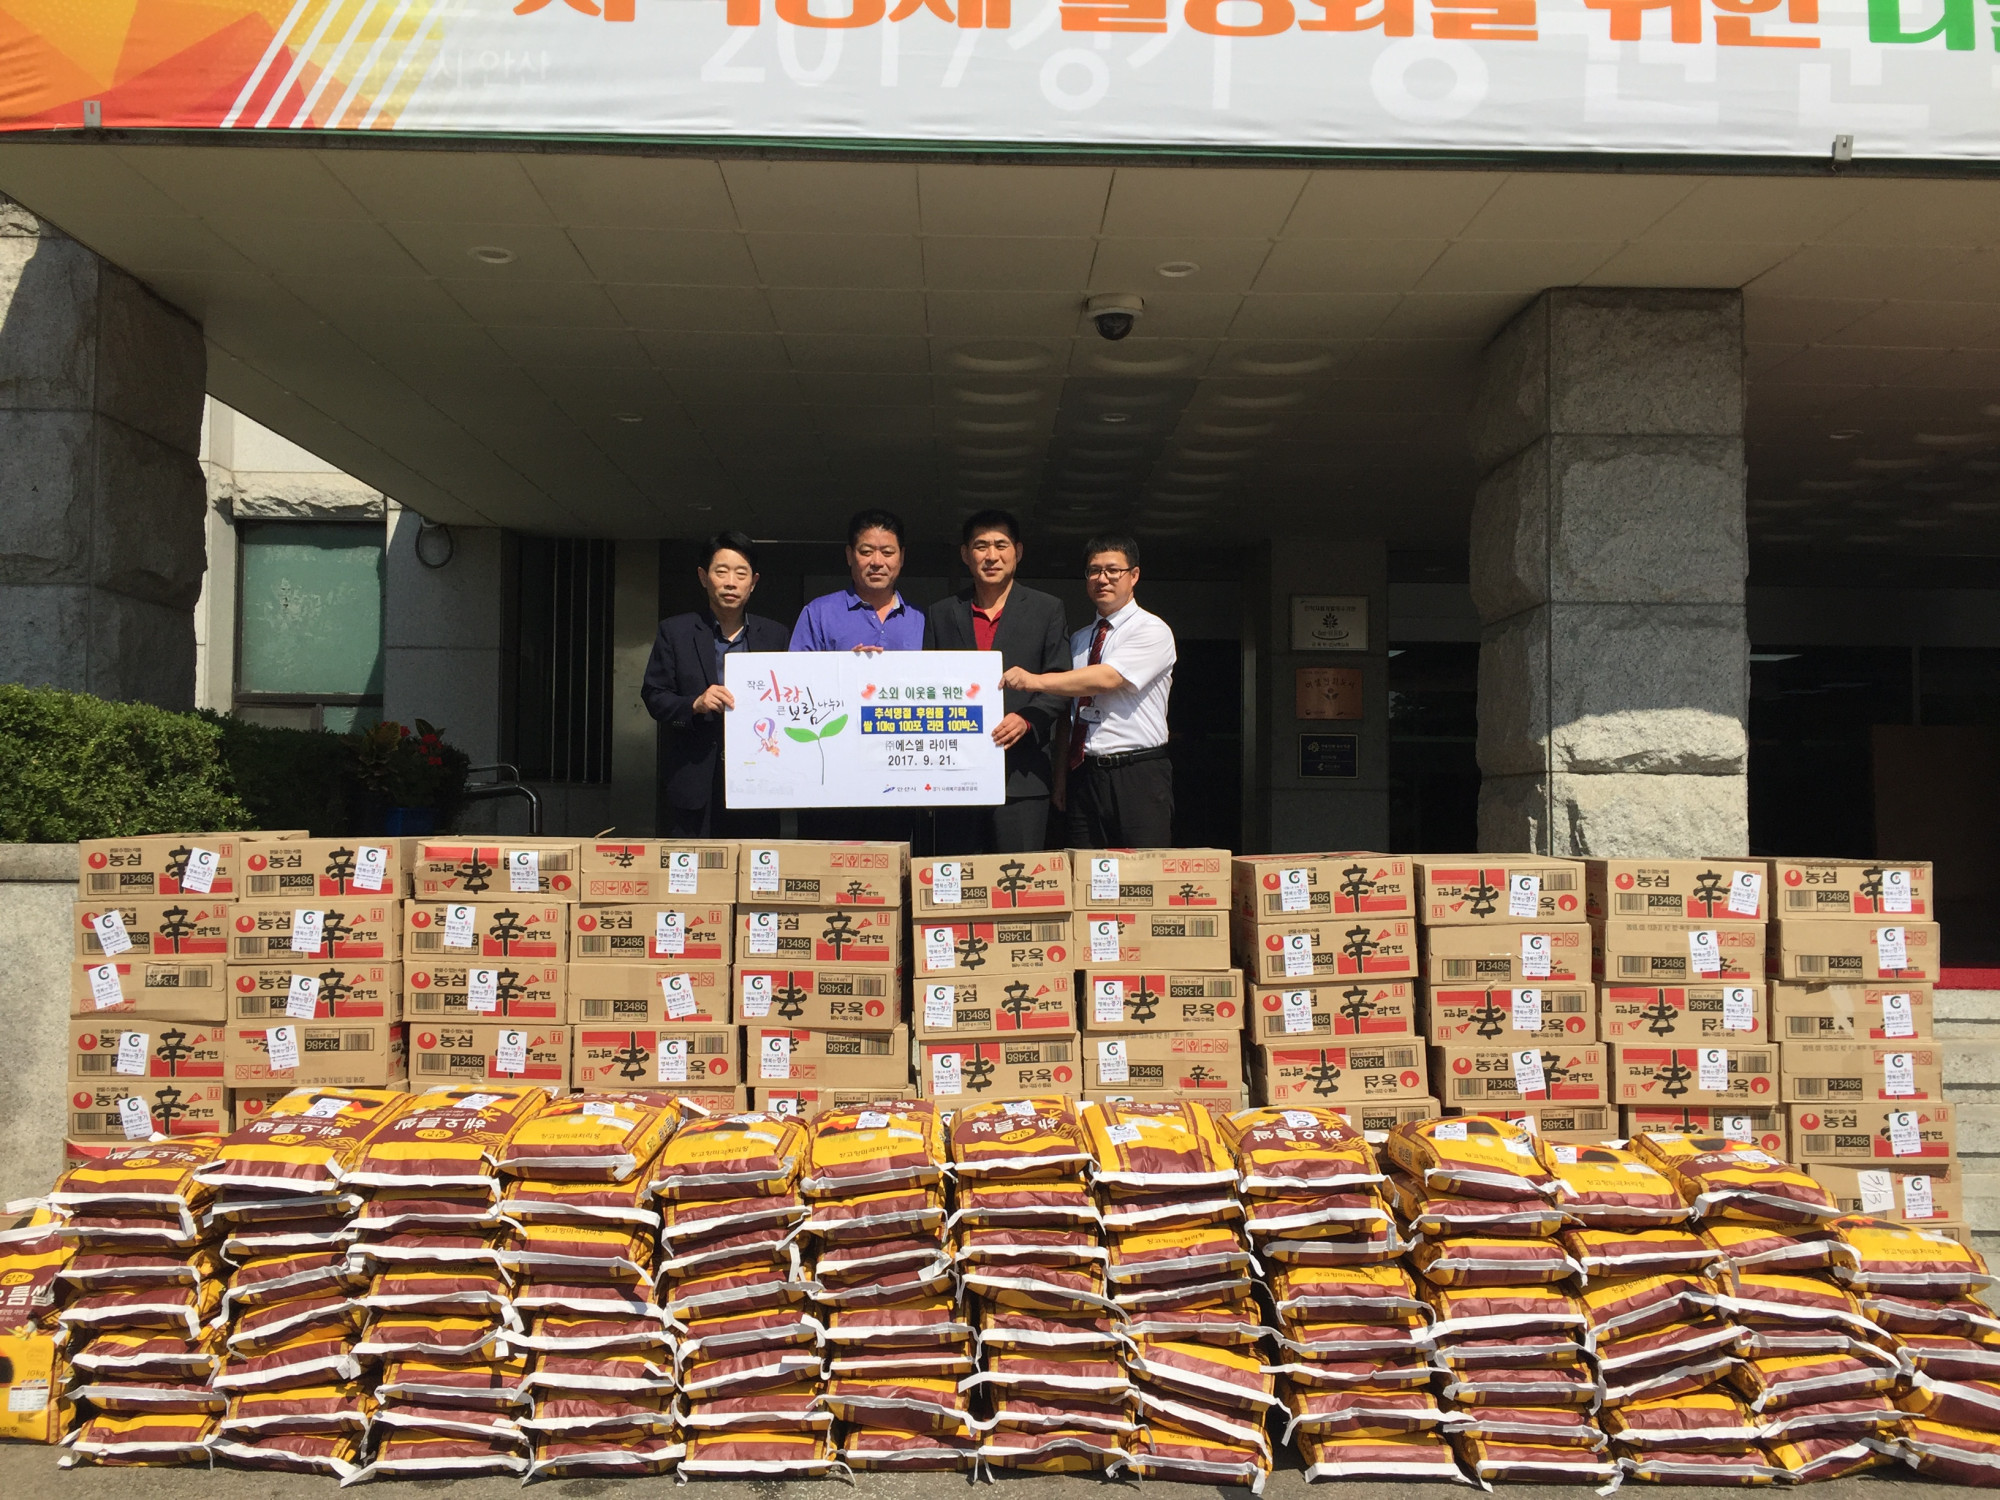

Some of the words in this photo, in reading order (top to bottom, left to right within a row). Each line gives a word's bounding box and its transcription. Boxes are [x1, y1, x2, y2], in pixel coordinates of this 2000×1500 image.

[747, 681, 765, 690] 작은
[760, 670, 803, 702] 사랑
[878, 687, 898, 700] 소외
[905, 687, 936, 700] 이웃을
[943, 687, 963, 700] 위한
[777, 706, 786, 715] 큰
[789, 687, 823, 725] 보람
[818, 697, 844, 711] 나누기
[875, 707, 911, 719] 추석명절
[916, 707, 943, 719] 후원품
[949, 707, 967, 718] 기탁
[864, 721, 872, 732] 쌀
[876, 721, 895, 732] 10kg
[927, 720, 943, 731] 라면
[948, 720, 978, 731] 100박스
[930, 739, 958, 751] 라이텍
[888, 755, 917, 766] 2017.
[923, 755, 933, 766] 9.
[939, 755, 955, 766] 21.
[109, 854, 142, 867] 농심
[269, 854, 302, 867] 농심
[429, 864, 453, 873] 라면
[454, 848, 492, 894] 辛
[121, 873, 153, 884] 가3486
[281, 875, 313, 886] 가3486
[997, 859, 1034, 907] 辛
[1637, 875, 1669, 888] 농심
[1806, 871, 1837, 884] 농심
[787, 881, 819, 891] 가3486
[1034, 879, 1057, 889] 라면
[1340, 864, 1377, 913] 辛
[1376, 884, 1400, 894] 라면
[1121, 886, 1151, 896] 가3486
[1437, 887, 1461, 896] 라면
[1461, 870, 1498, 918] 辛
[1693, 869, 1730, 918] 辛
[1817, 892, 1849, 901] 가3486
[1649, 895, 1681, 906] 가3486
[257, 916, 291, 930] 농심
[600, 916, 633, 929] 농심
[160, 906, 197, 954] 辛
[197, 927, 221, 936] 라면
[490, 908, 527, 956] 辛
[527, 930, 551, 940] 라면
[823, 911, 860, 959] 辛
[1152, 924, 1184, 935] 가3486
[353, 932, 377, 941] 라면
[611, 936, 643, 947] 가3486
[692, 932, 716, 941] 라면
[860, 934, 883, 944] 라면
[1000, 932, 1031, 942] 가3486
[1011, 948, 1044, 961] 농심
[1343, 925, 1380, 973] 辛
[1379, 945, 1403, 955] 라면
[1477, 960, 1510, 971] 가3486
[1653, 958, 1685, 968] 가3486
[1829, 957, 1862, 967] 가3486
[258, 976, 292, 989] 농심
[434, 974, 467, 986] 농심
[353, 990, 377, 999] 라면
[527, 990, 551, 1000] 라면
[820, 984, 851, 995] 가3486
[1170, 986, 1203, 996] 가3486
[771, 971, 807, 1020] 辛
[1123, 976, 1159, 1024] 辛
[614, 1001, 646, 1011] 가3486
[831, 1002, 863, 1015] 농심
[1001, 981, 1038, 1029] 辛
[1039, 1001, 1063, 1011] 라면
[1183, 1004, 1215, 1017] 농심
[1340, 986, 1377, 1034] 辛
[1615, 1005, 1640, 1014] 라면
[958, 1009, 990, 1021] 가3486
[1376, 1006, 1400, 1016] 라면
[1443, 1009, 1468, 1018] 라면
[1467, 989, 1506, 1039] 辛
[1640, 989, 1678, 1037] 辛
[306, 1039, 338, 1050] 가3486
[440, 1034, 473, 1047] 농심
[156, 1028, 194, 1077] 辛
[588, 1049, 612, 1058] 라면
[827, 1043, 859, 1053] 가3486
[194, 1050, 218, 1059] 라면
[532, 1052, 556, 1062] 라면
[612, 1031, 650, 1081] 辛
[1006, 1052, 1038, 1063] 가3486
[452, 1056, 483, 1066] 가3486
[1351, 1057, 1384, 1068] 가3486
[1475, 1058, 1509, 1071] 농심
[961, 1043, 994, 1091] 辛
[1131, 1066, 1162, 1076] 가3486
[1279, 1067, 1304, 1077] 라면
[1629, 1066, 1654, 1076] 라면
[1019, 1069, 1051, 1081] 농심
[1303, 1049, 1340, 1097] 辛
[1568, 1072, 1593, 1082] 라면
[1653, 1050, 1692, 1098] 辛
[1364, 1076, 1397, 1088] 농심
[1829, 1079, 1862, 1089] 가3486
[152, 1086, 189, 1134] 辛
[189, 1109, 214, 1118] 라면
[394, 1117, 486, 1131] 해오름쌀
[971, 1118, 1060, 1135] 해오름쌀
[1364, 1119, 1396, 1129] 가3486
[1542, 1121, 1574, 1130] 가3486
[1824, 1115, 1857, 1128] 농심
[249, 1122, 342, 1137] 해오름쌀
[1253, 1129, 1342, 1142] 해오름쌀
[1836, 1136, 1869, 1146] 가3486
